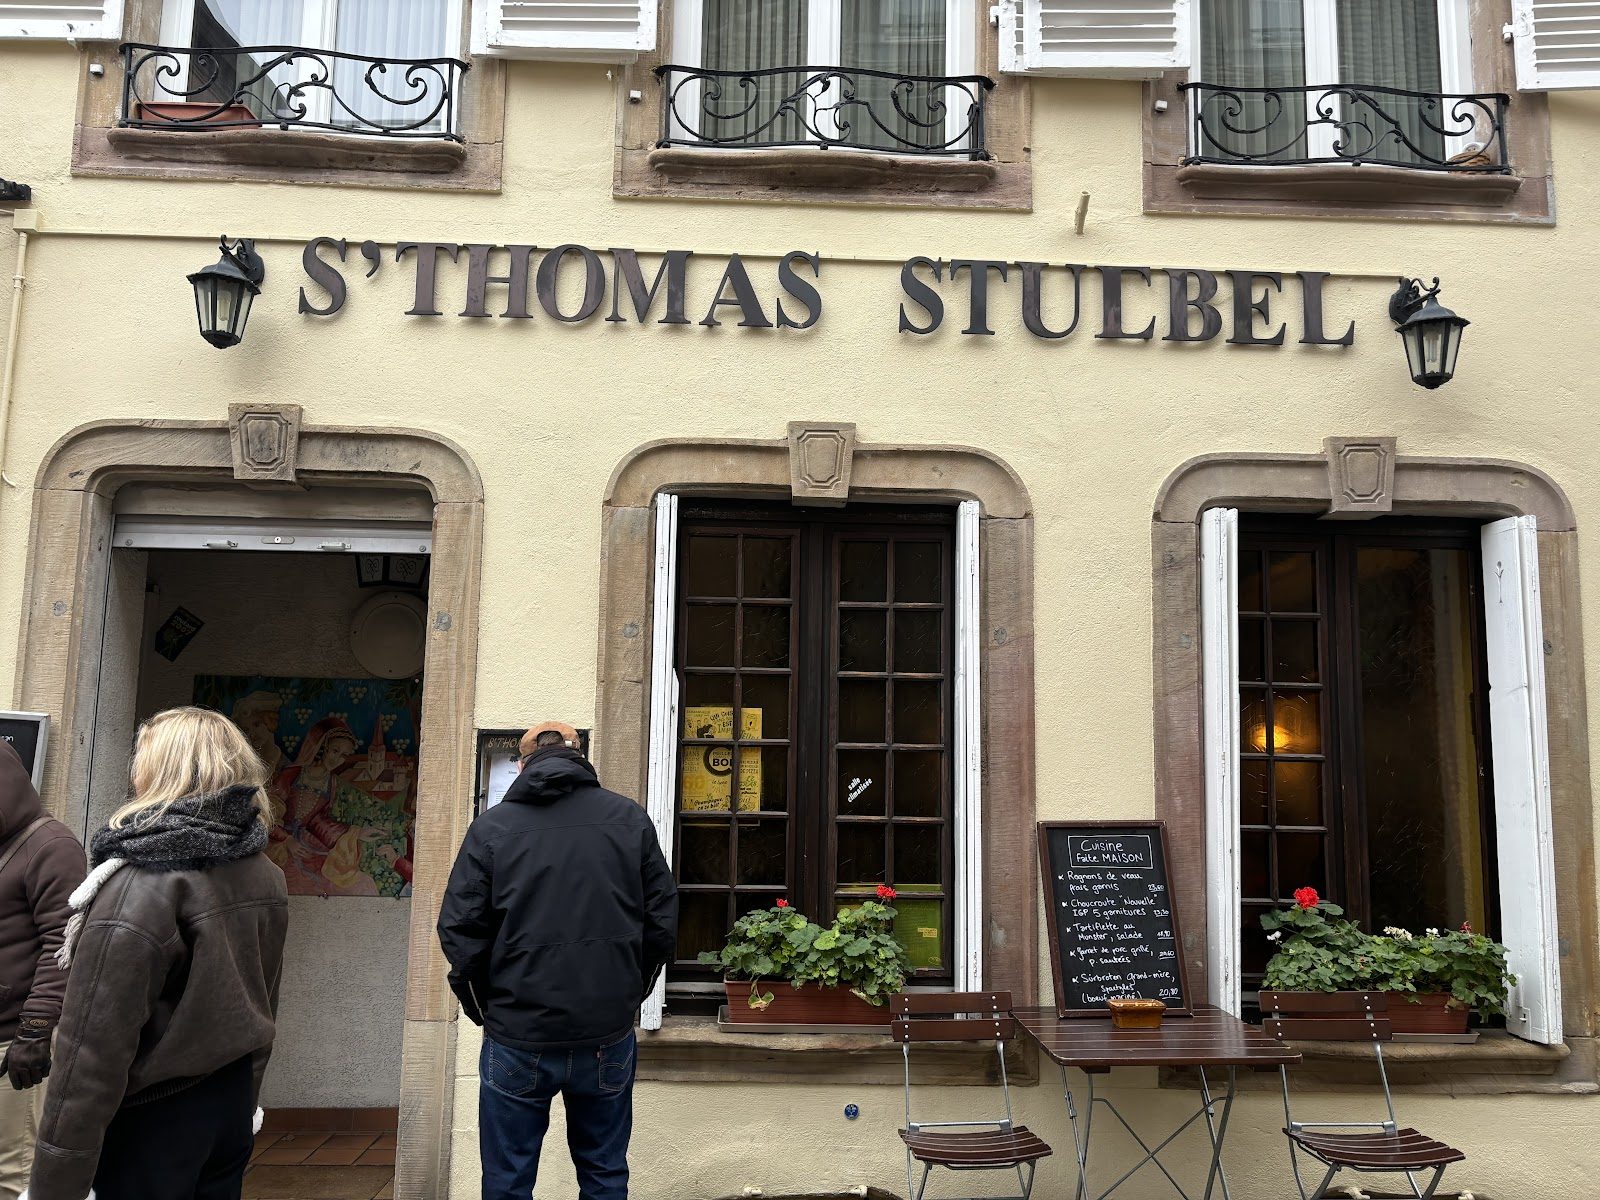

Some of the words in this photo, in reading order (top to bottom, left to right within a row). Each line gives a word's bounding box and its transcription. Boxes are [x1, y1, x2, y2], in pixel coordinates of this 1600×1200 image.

[299, 237, 822, 328] S'THOMAS
[1081, 840, 1124, 851] Cuisine
[1067, 871, 1102, 883] Rognons
[1107, 872, 1117, 880] de
[1069, 884, 1089, 895] frais
[1092, 883, 1119, 894] garnis
[1071, 898, 1116, 907] Choucroute
[1093, 909, 1100, 917] 5
[1103, 908, 1146, 919] garnitures
[1073, 922, 1119, 932] Tartiflette
[1117, 932, 1143, 940] salade
